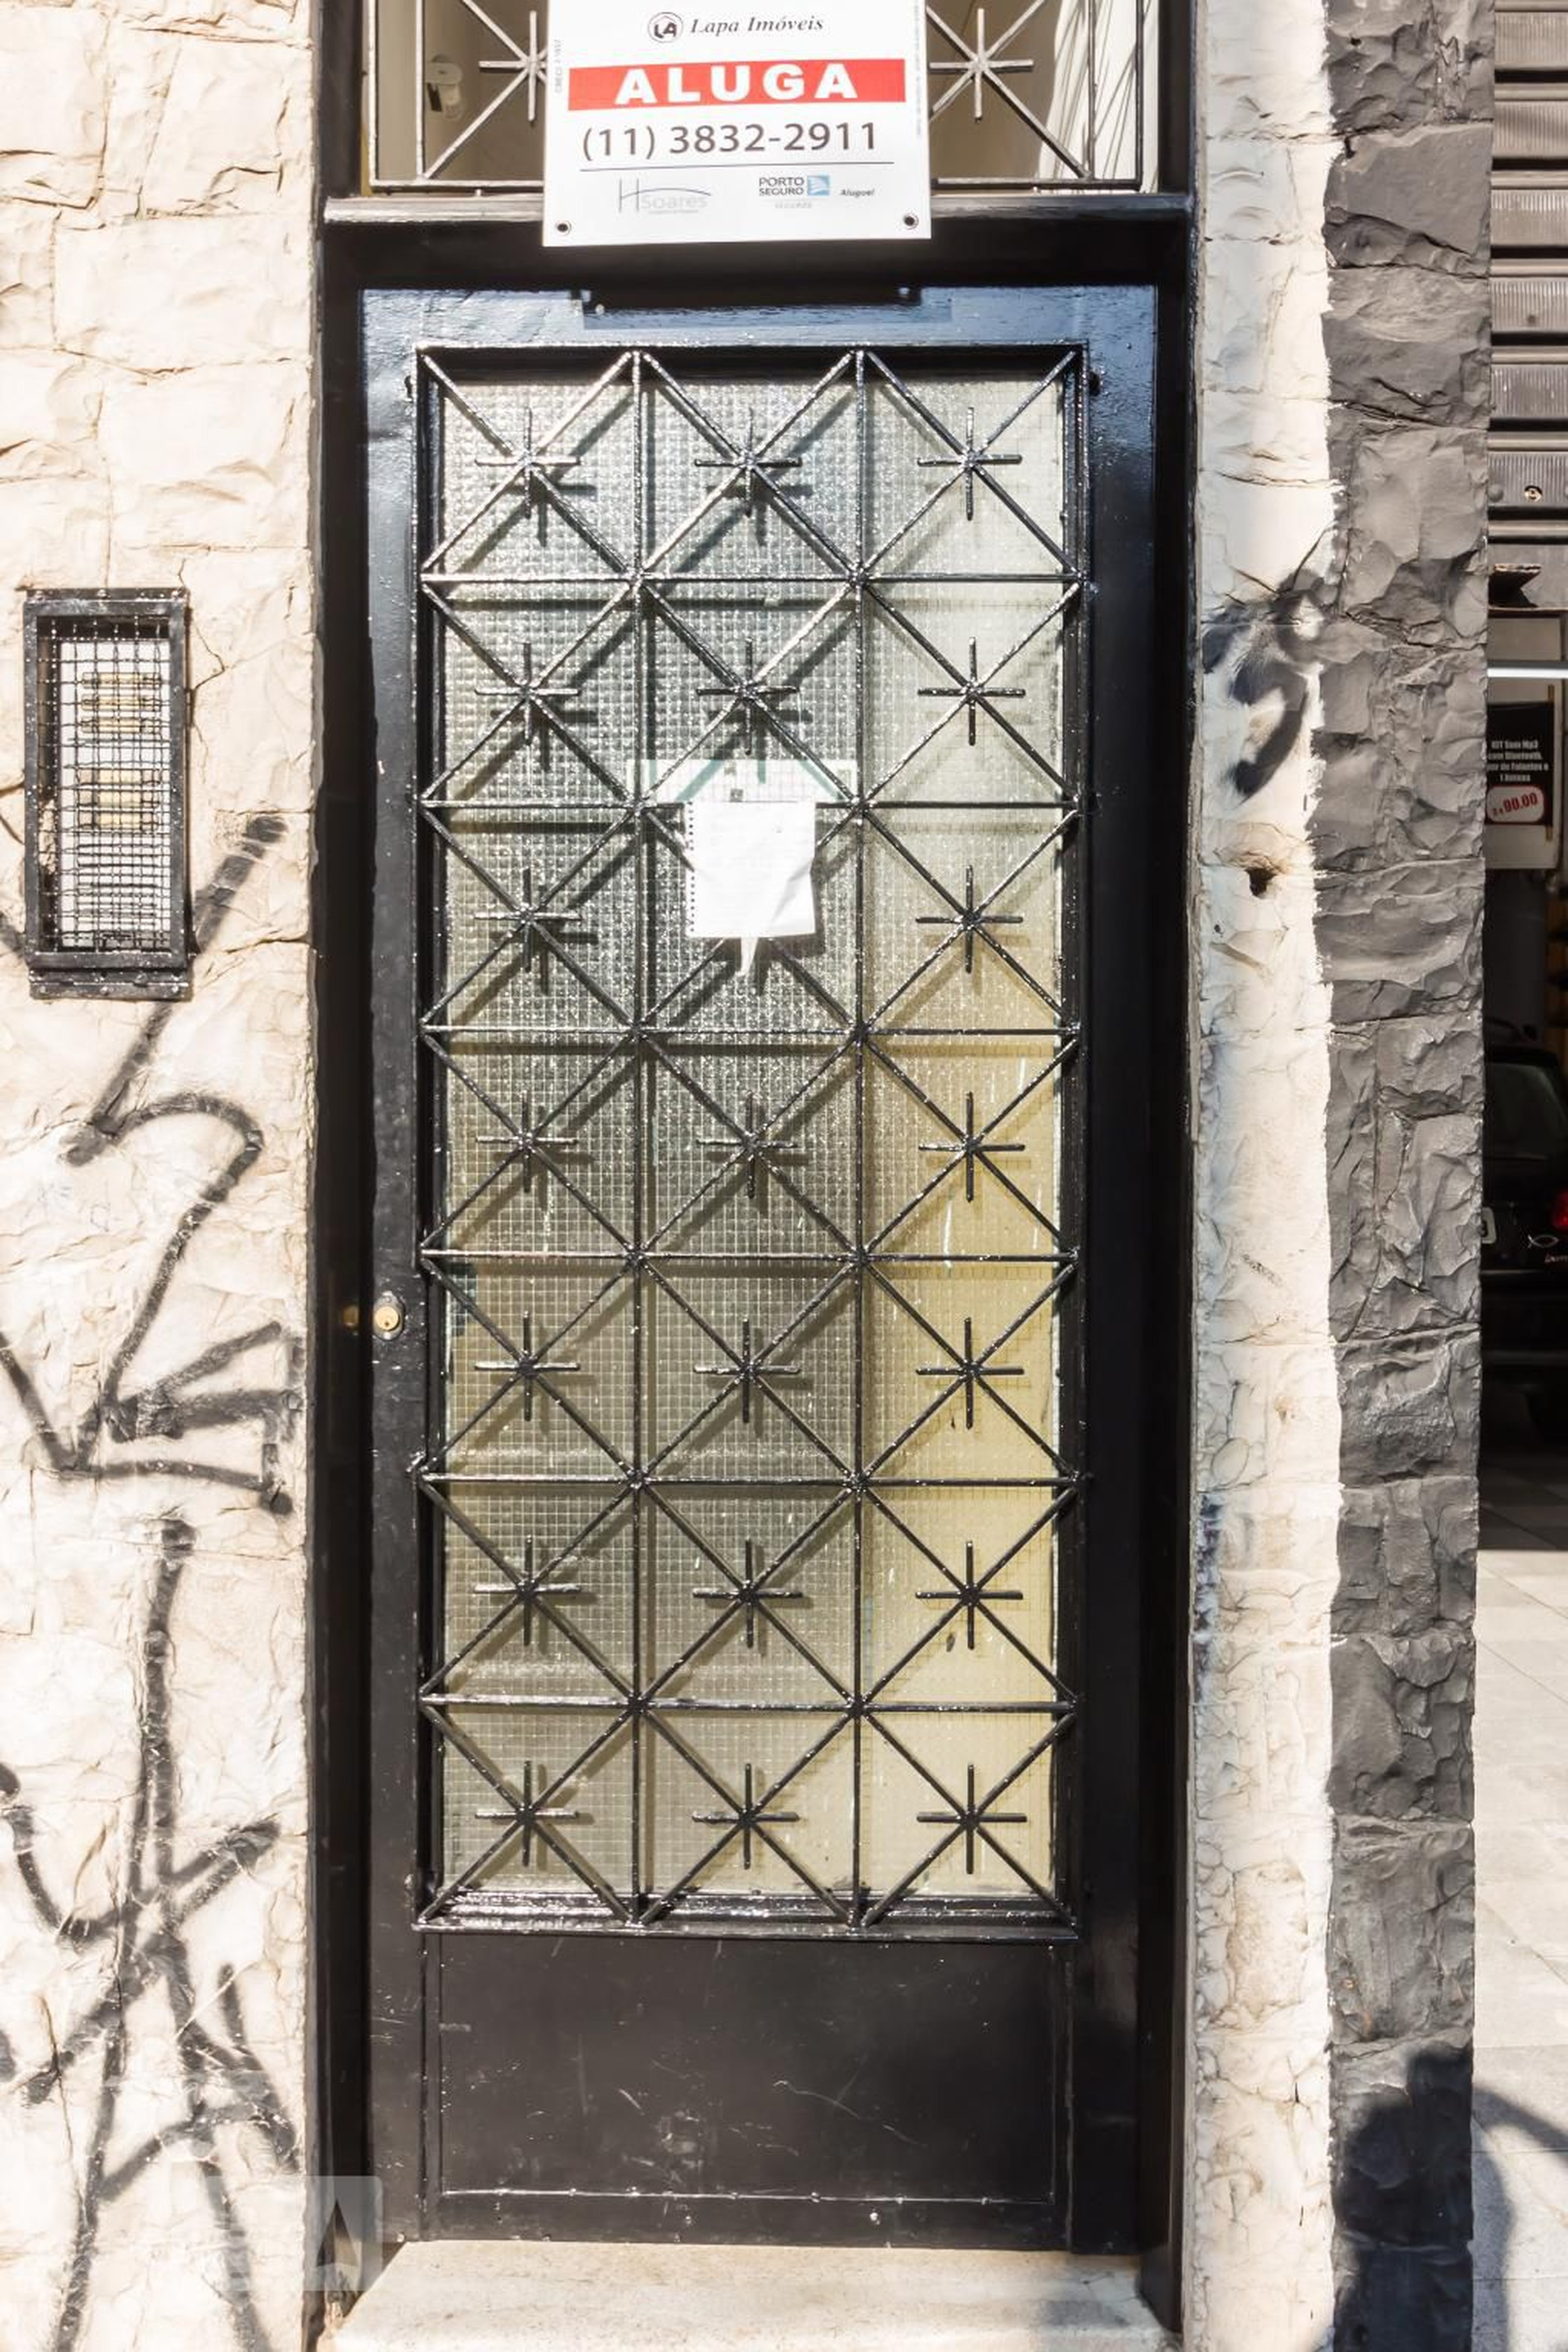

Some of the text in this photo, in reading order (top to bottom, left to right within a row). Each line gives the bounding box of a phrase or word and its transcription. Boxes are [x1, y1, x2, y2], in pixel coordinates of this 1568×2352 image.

[691, 15, 824, 37] Lapa Imóveis
[614, 63, 858, 105] ALUGA
[583, 122, 875, 161] (11) 3832-2911
[759, 177, 804, 187] PORTO
[759, 187, 804, 196] SEGURO
